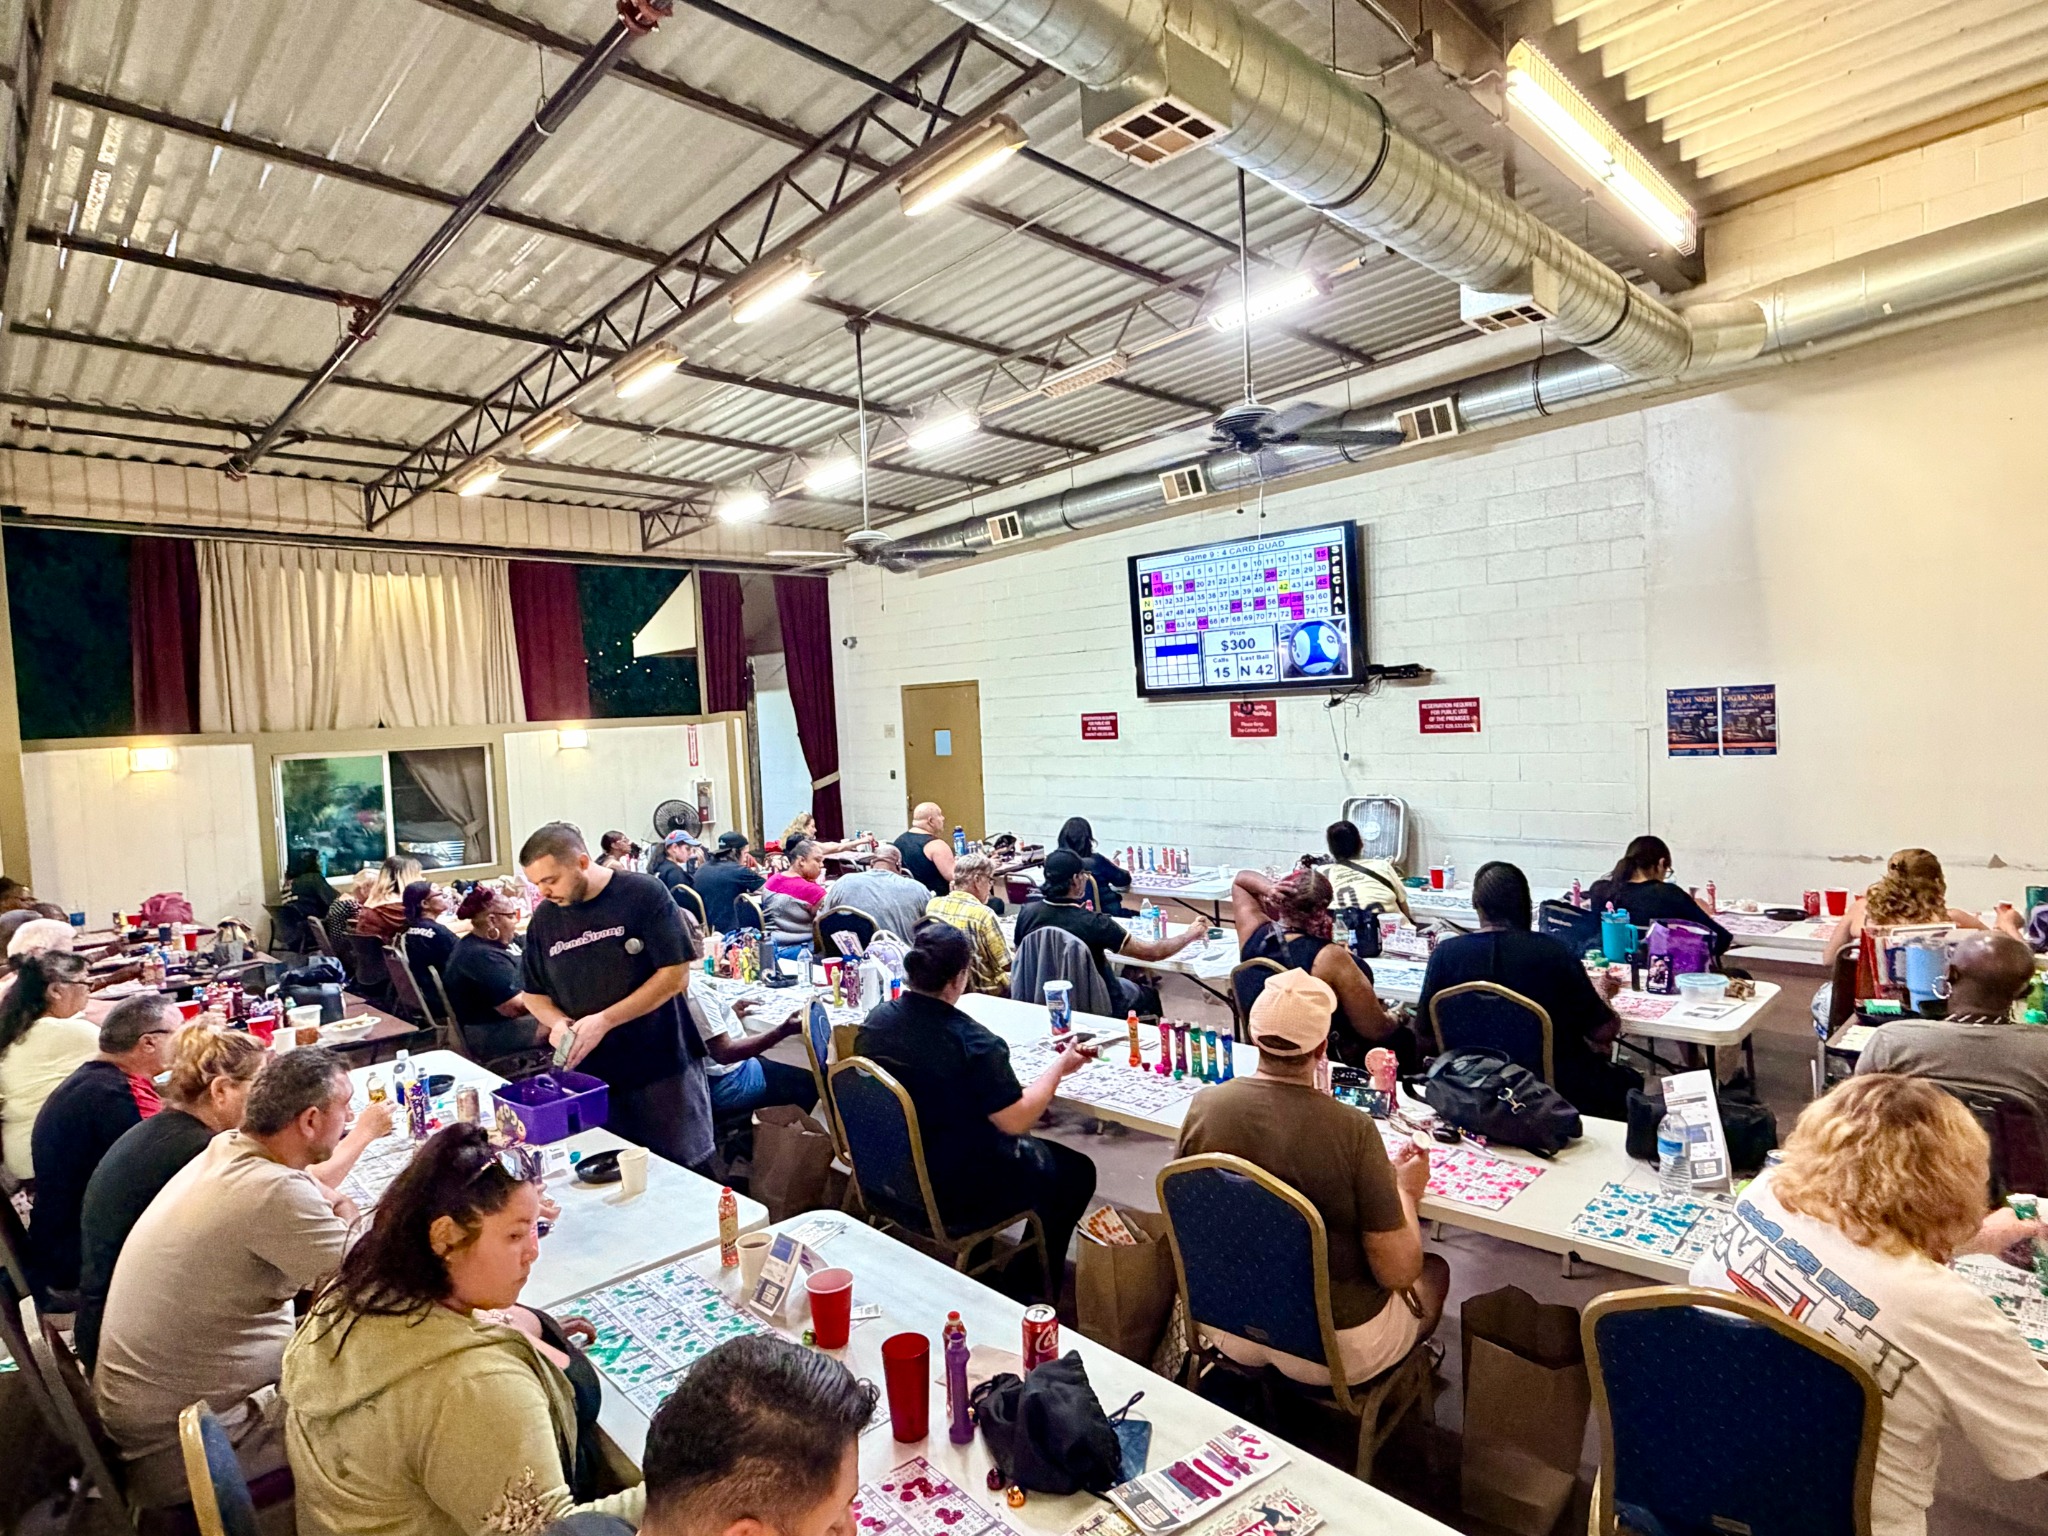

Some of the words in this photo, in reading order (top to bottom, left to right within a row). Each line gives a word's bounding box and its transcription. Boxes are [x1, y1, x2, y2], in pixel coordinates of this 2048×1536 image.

[1229, 545, 1255, 554] CARD
[1258, 540, 1285, 550] QUAD
[1221, 638, 1255, 651] $300
[1214, 667, 1230, 678] 15
[1240, 666, 1250, 676] N
[1256, 664, 1274, 675] 42
[549, 926, 625, 957] #DenaStrong
